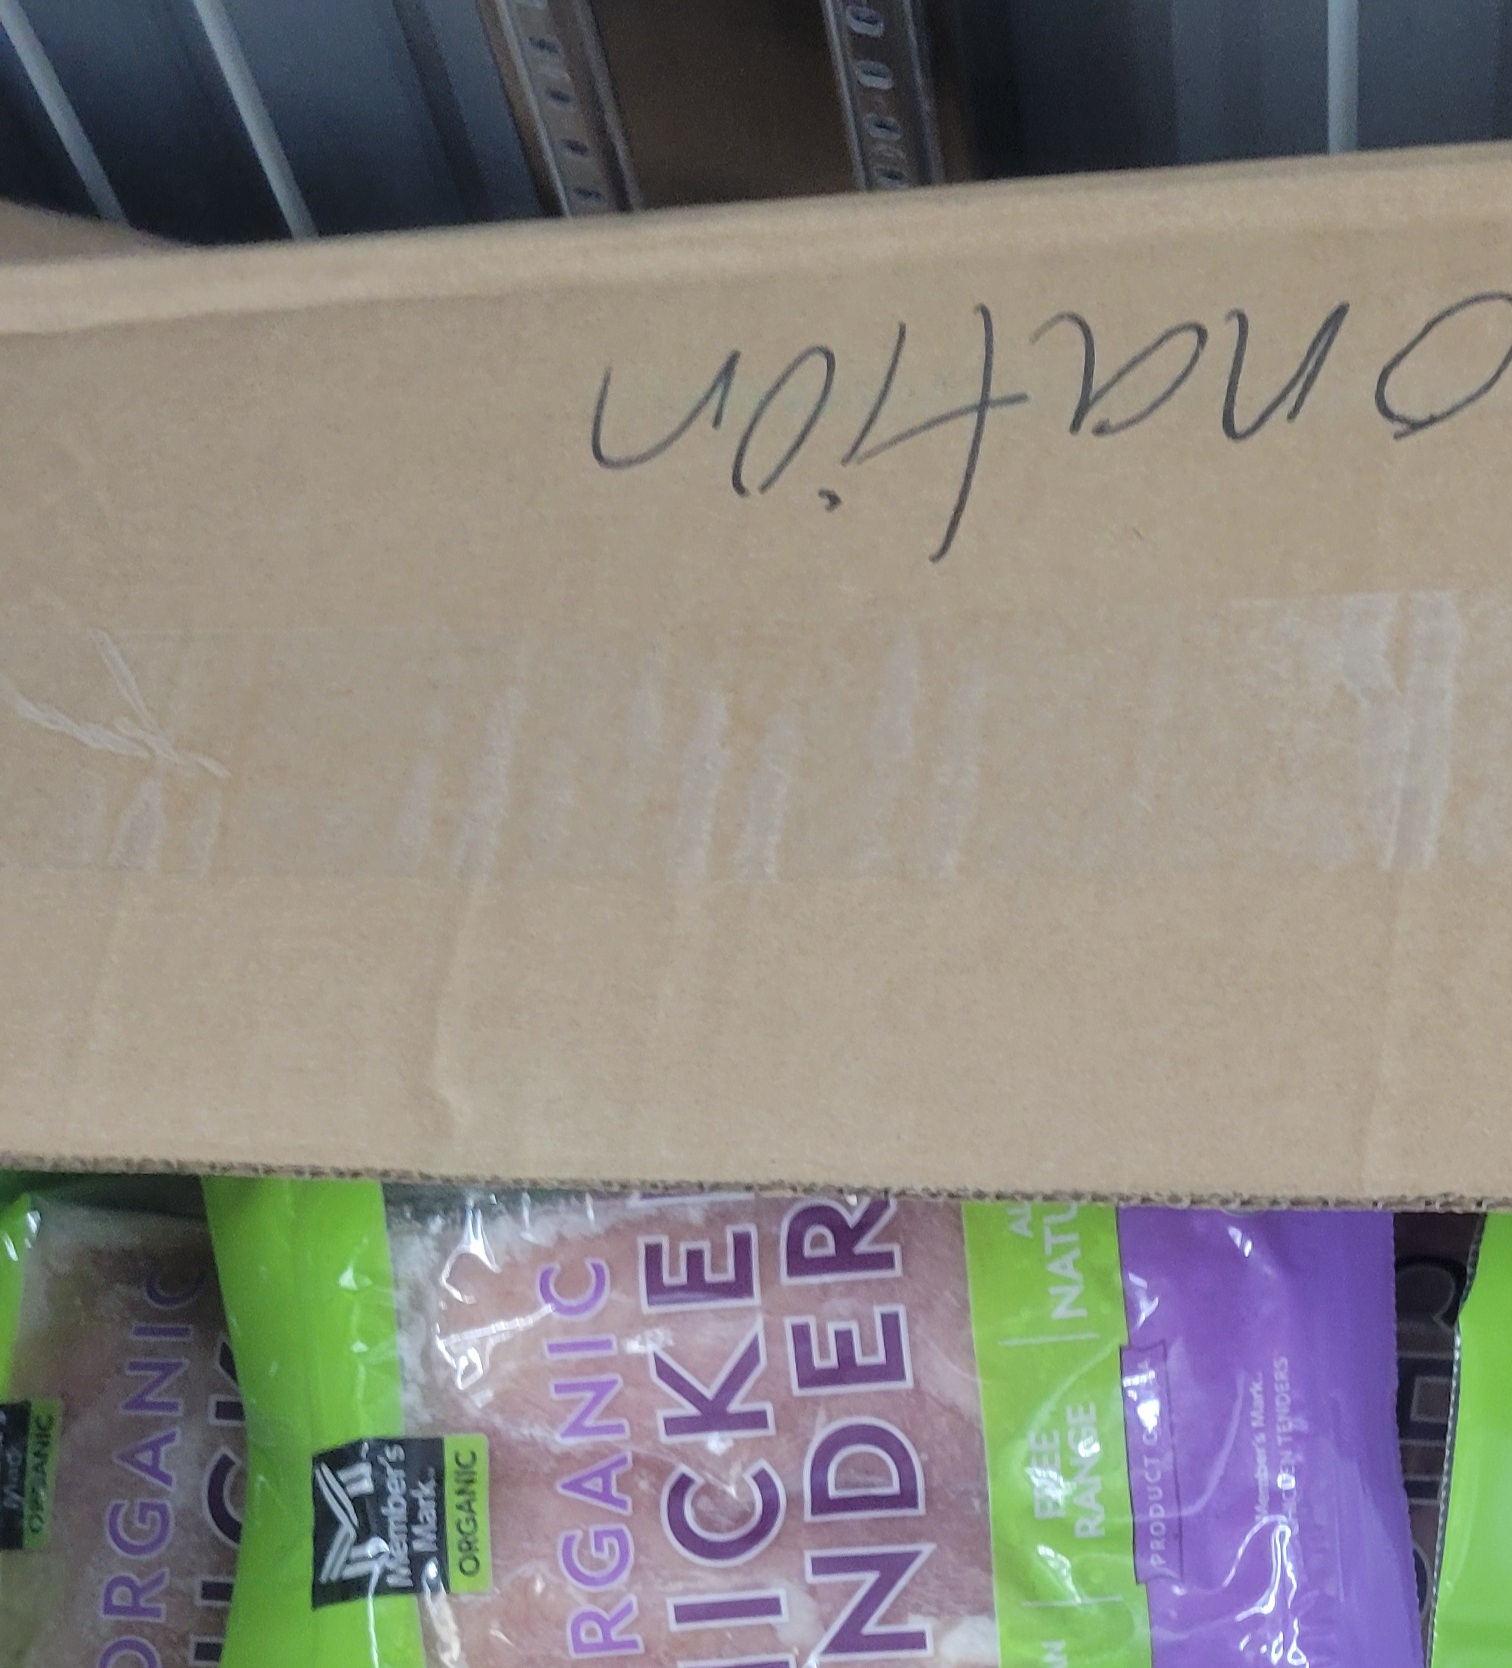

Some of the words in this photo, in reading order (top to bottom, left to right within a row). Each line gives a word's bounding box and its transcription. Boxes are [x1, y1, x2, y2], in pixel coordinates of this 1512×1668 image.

[1273, 1357, 1293, 1446] TENDERS
[452, 1451, 482, 1578] ORGANIC
[1064, 1403, 1105, 1538] RANGE
[1143, 1454, 1167, 1567] PRODUCT
